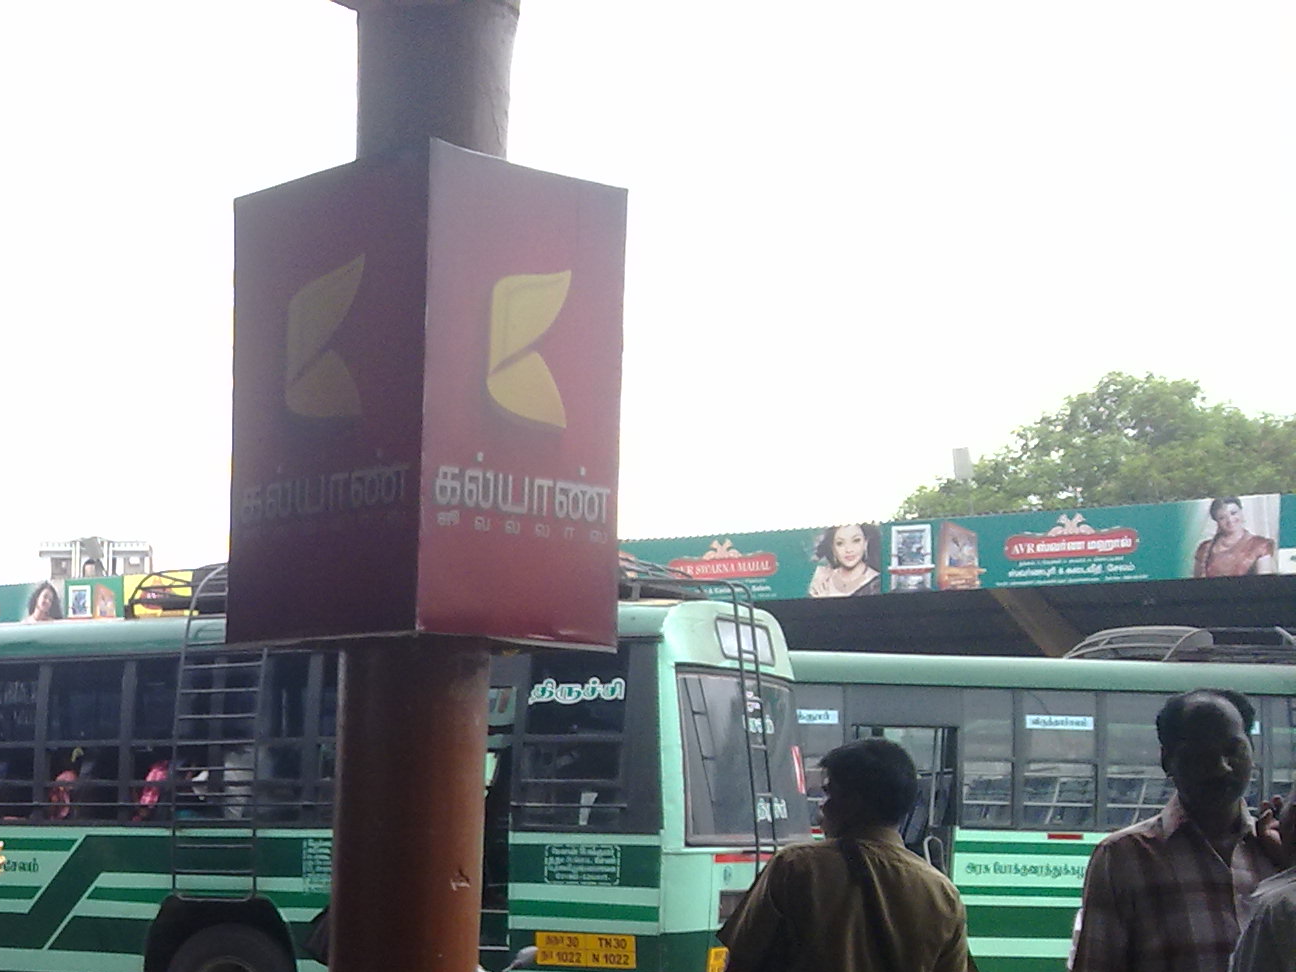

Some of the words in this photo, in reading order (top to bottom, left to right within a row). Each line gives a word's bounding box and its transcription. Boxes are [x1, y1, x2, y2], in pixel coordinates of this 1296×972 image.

[433, 450, 611, 524] கல்யாண்
[695, 564, 735, 575] SWARNA
[737, 560, 772, 573] MAHAL
[528, 676, 626, 706] திருச்சி
[598, 937, 612, 948] TN
[614, 937, 628, 950] 30
[556, 951, 582, 964] 1022
[592, 953, 600, 963] N
[603, 953, 630, 966] 1022
